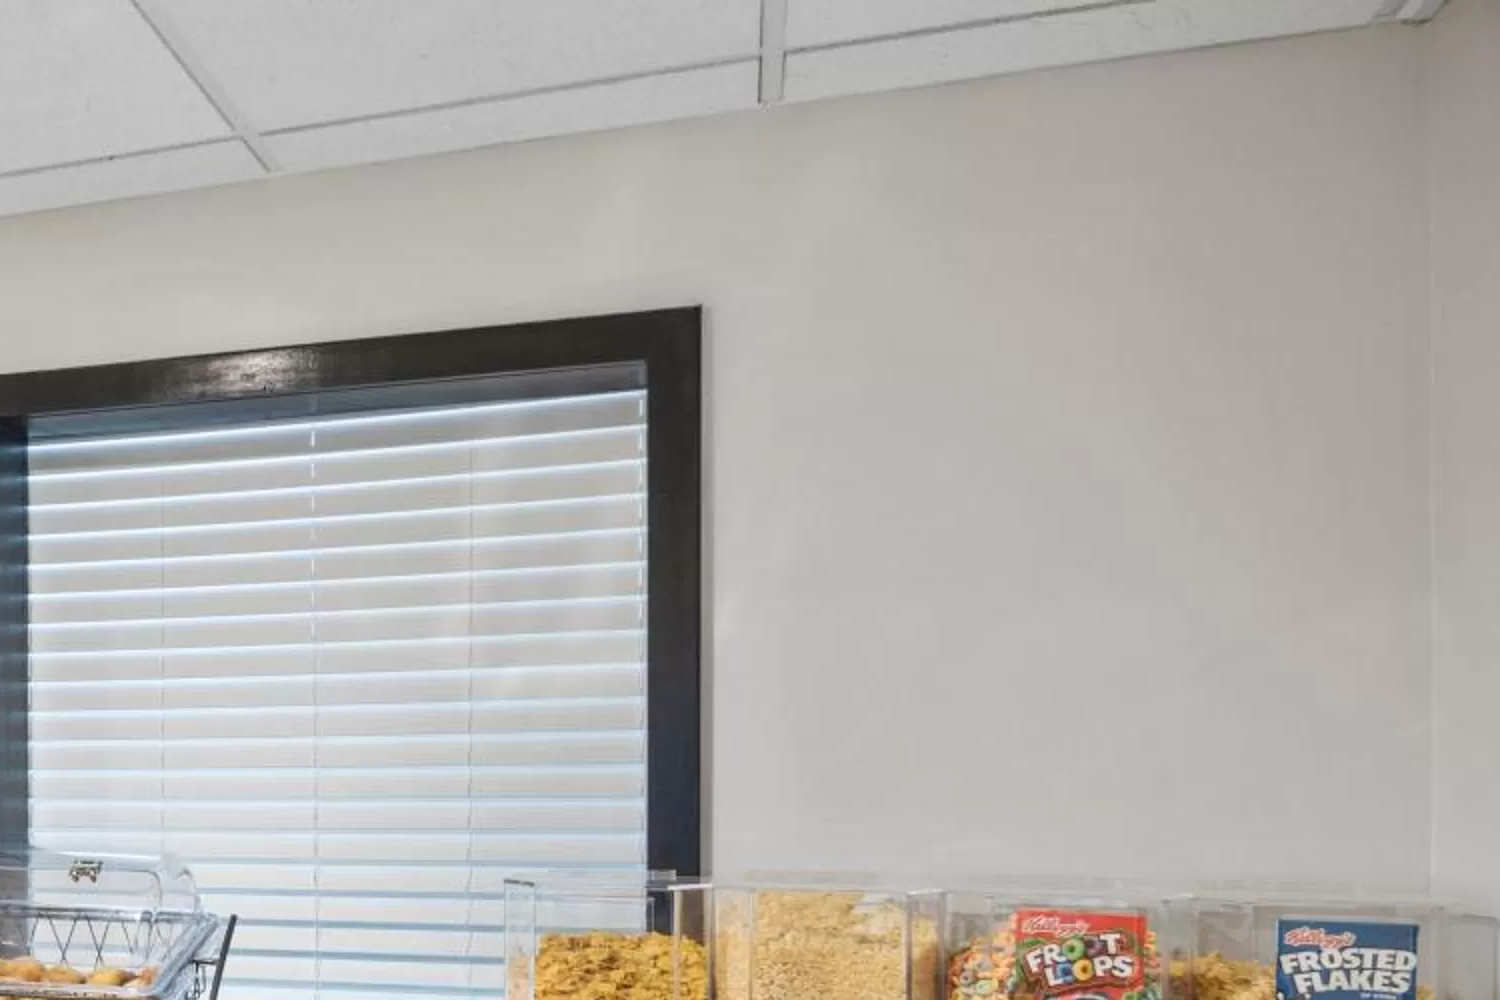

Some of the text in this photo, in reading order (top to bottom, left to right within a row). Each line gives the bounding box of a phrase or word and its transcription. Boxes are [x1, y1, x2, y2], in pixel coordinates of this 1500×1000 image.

[1045, 955, 1134, 987] LOOPS
[1280, 947, 1417, 974] FROSTED
[1294, 969, 1412, 994] FLAKES
